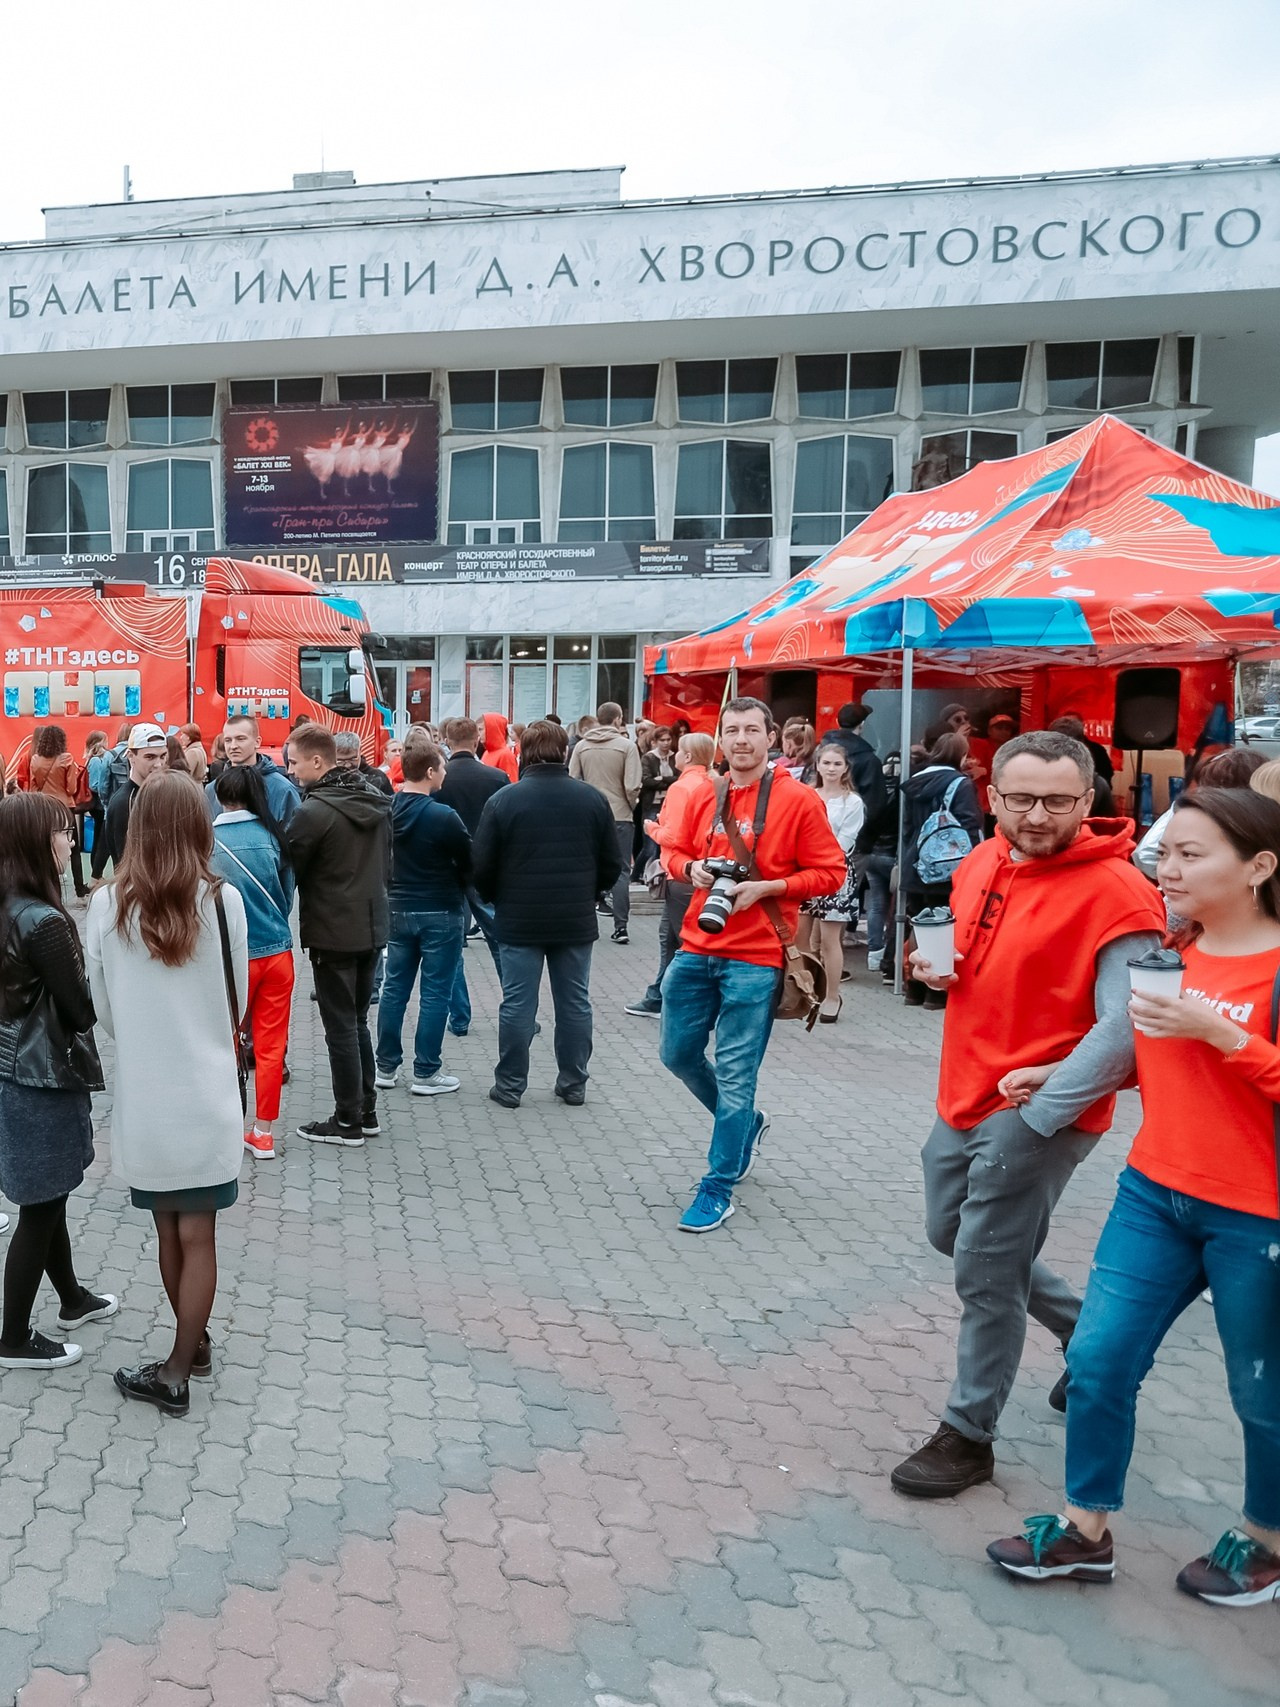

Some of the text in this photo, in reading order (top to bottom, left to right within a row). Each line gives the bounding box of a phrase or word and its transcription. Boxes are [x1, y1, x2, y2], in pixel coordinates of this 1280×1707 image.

[8, 275, 198, 319] БАЛЕТА
[234, 260, 436, 304] ИМЕНИ
[638, 208, 1262, 284] ХВОРОСТОВСКОГО
[233, 462, 259, 470] «БАЛЕТ
[251, 475, 268, 483] 7-13
[246, 483, 274, 493] ноября
[77, 553, 117, 562] ПОЛЮС
[456, 547, 595, 560] КРАСНОЯРСКИЙ ГОСУДАРСТВЕННЫЙ
[153, 554, 186, 585] 16
[404, 561, 444, 571] концерт
[456, 560, 547, 570] ТЕАТР ОПЕРЫ И БАЛЕТА
[456, 571, 483, 580] ИМЕНИ
[505, 569, 576, 578] ХВОРОСТОВСКОГО
[4, 647, 140, 667] #ТНТздесь
[4, 669, 141, 718] ТНТ
[228, 687, 289, 696] #ТНТздесь
